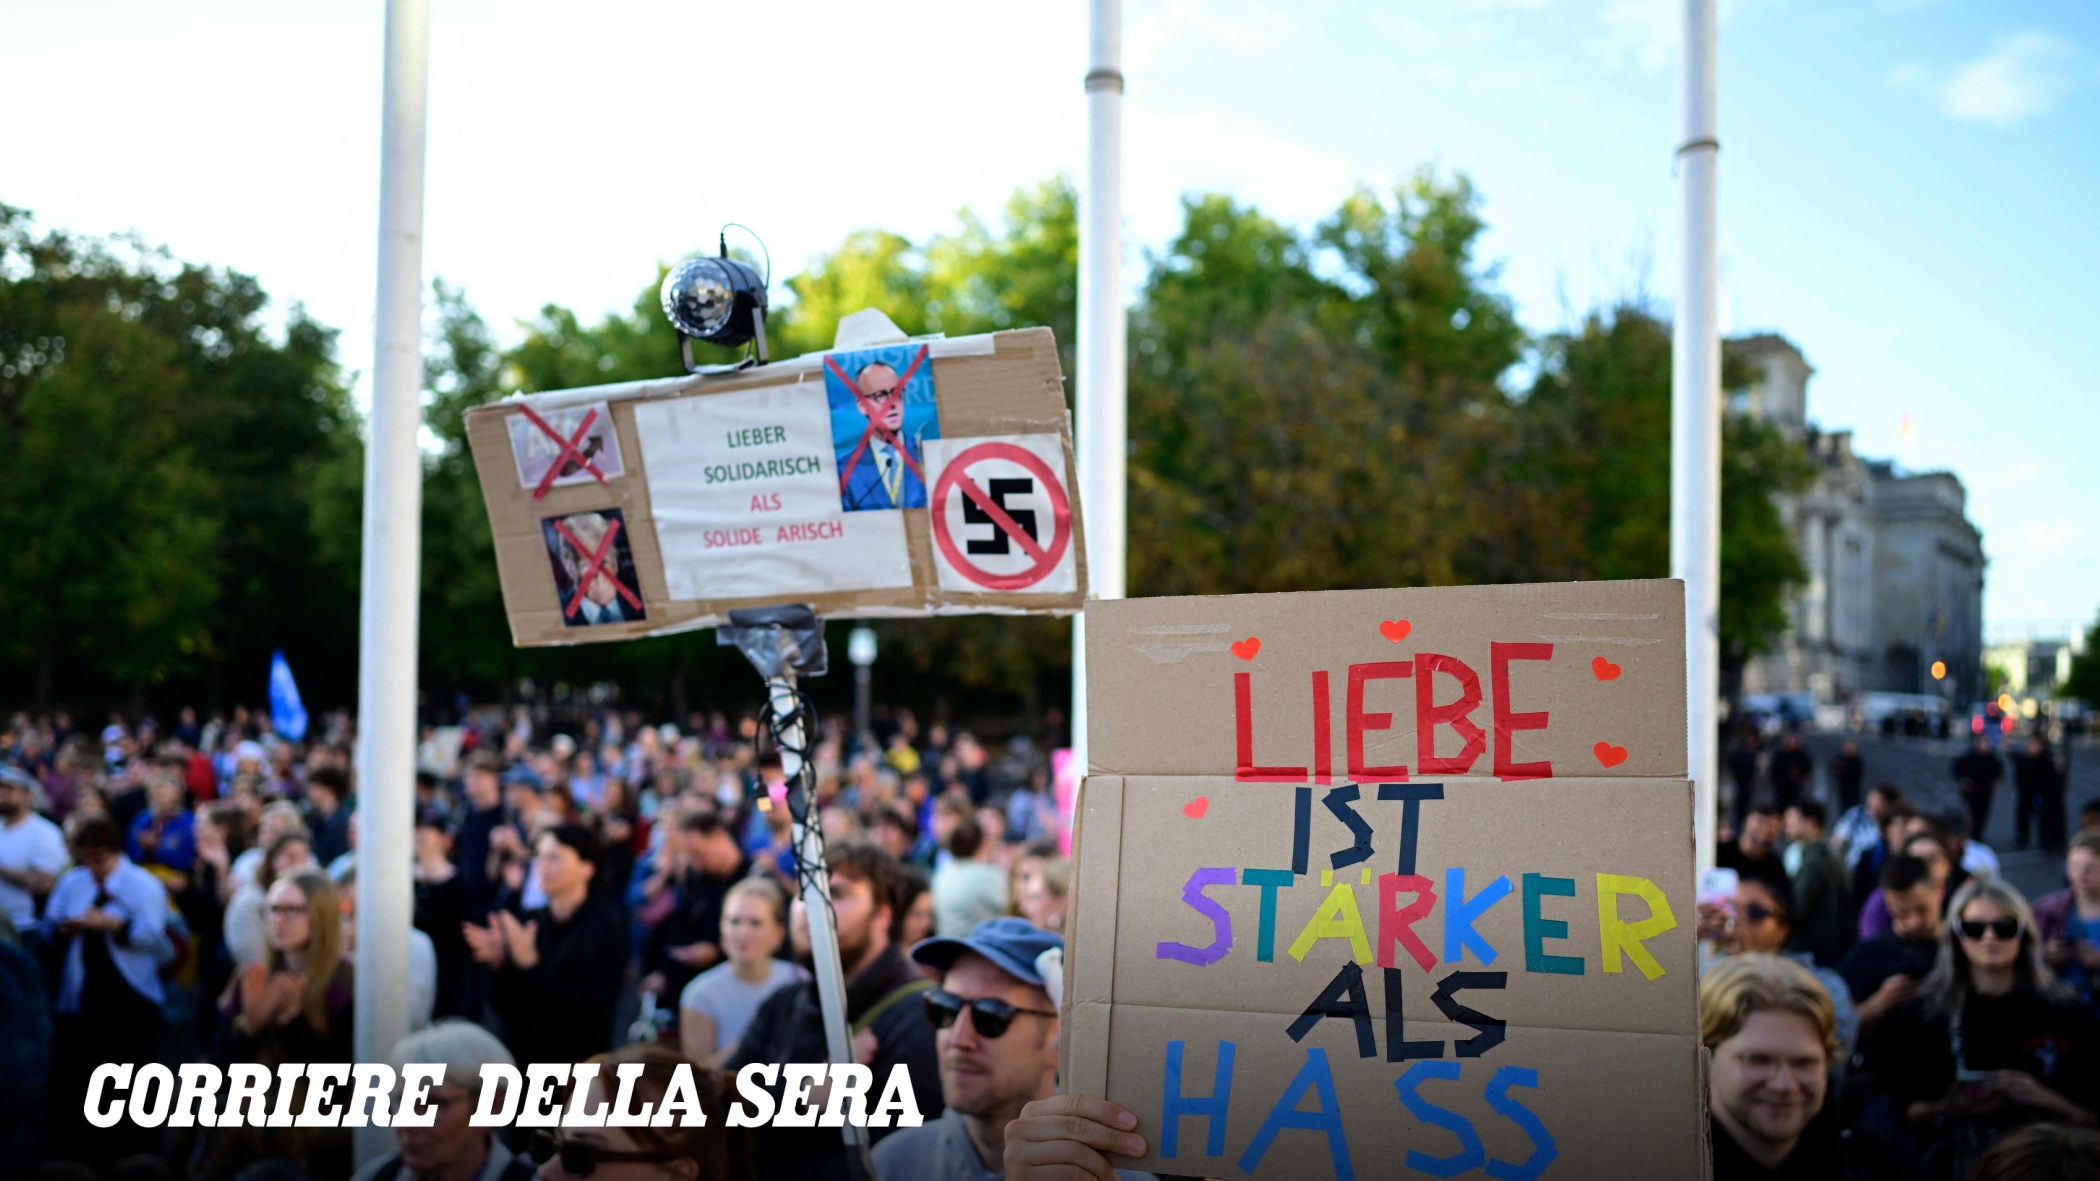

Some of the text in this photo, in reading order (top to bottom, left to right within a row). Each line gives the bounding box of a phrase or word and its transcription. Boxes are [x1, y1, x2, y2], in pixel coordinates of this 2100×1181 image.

[704, 455, 821, 484] SOLIDARISCH
[727, 425, 787, 449] LIEBER
[703, 520, 844, 549] SOLIDE ARISCH
[750, 492, 782, 513] ALS
[1233, 641, 1555, 785] LIEBE
[1291, 783, 1445, 876] IST
[1155, 867, 1678, 982] STÄRKER
[1285, 960, 1509, 1063] ALS
[1160, 1039, 1560, 1181] HASS
